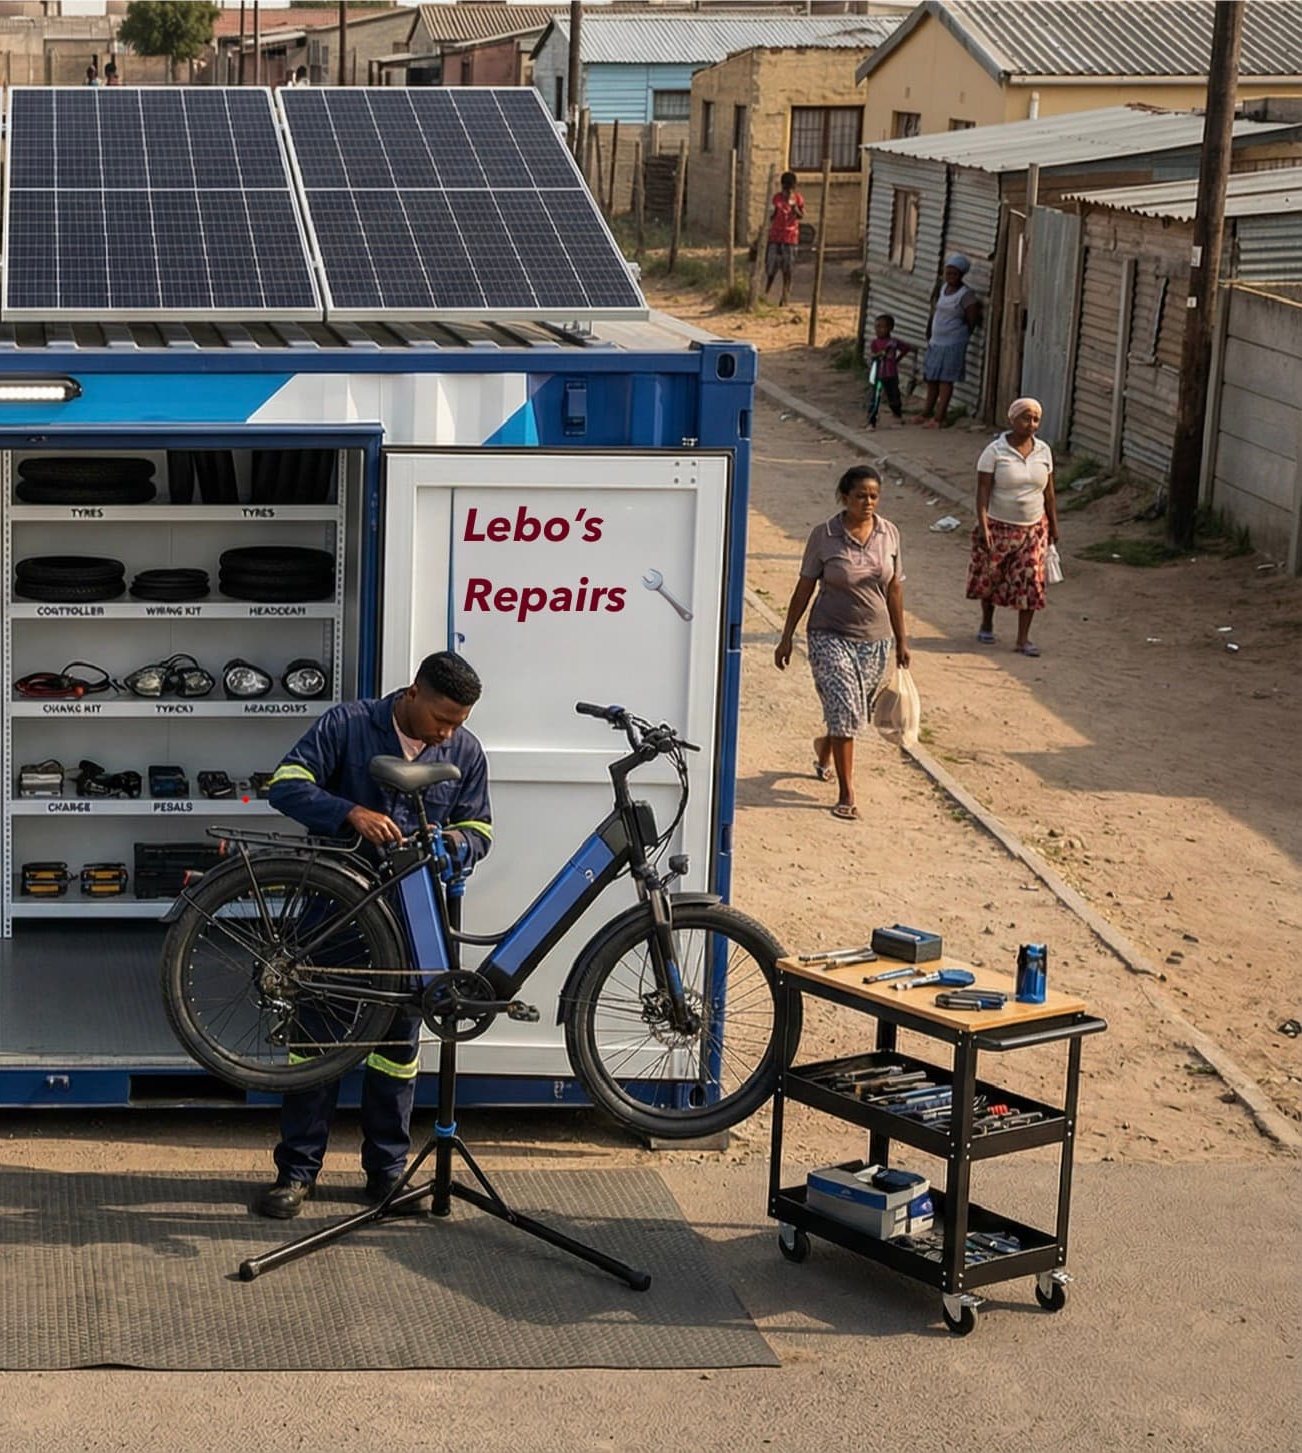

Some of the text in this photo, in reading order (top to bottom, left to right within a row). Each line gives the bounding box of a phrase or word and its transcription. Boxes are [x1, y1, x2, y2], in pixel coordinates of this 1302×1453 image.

[71, 508, 104, 518] TYRES
[242, 508, 275, 518] TYRES
[463, 576, 627, 622] Repairs
